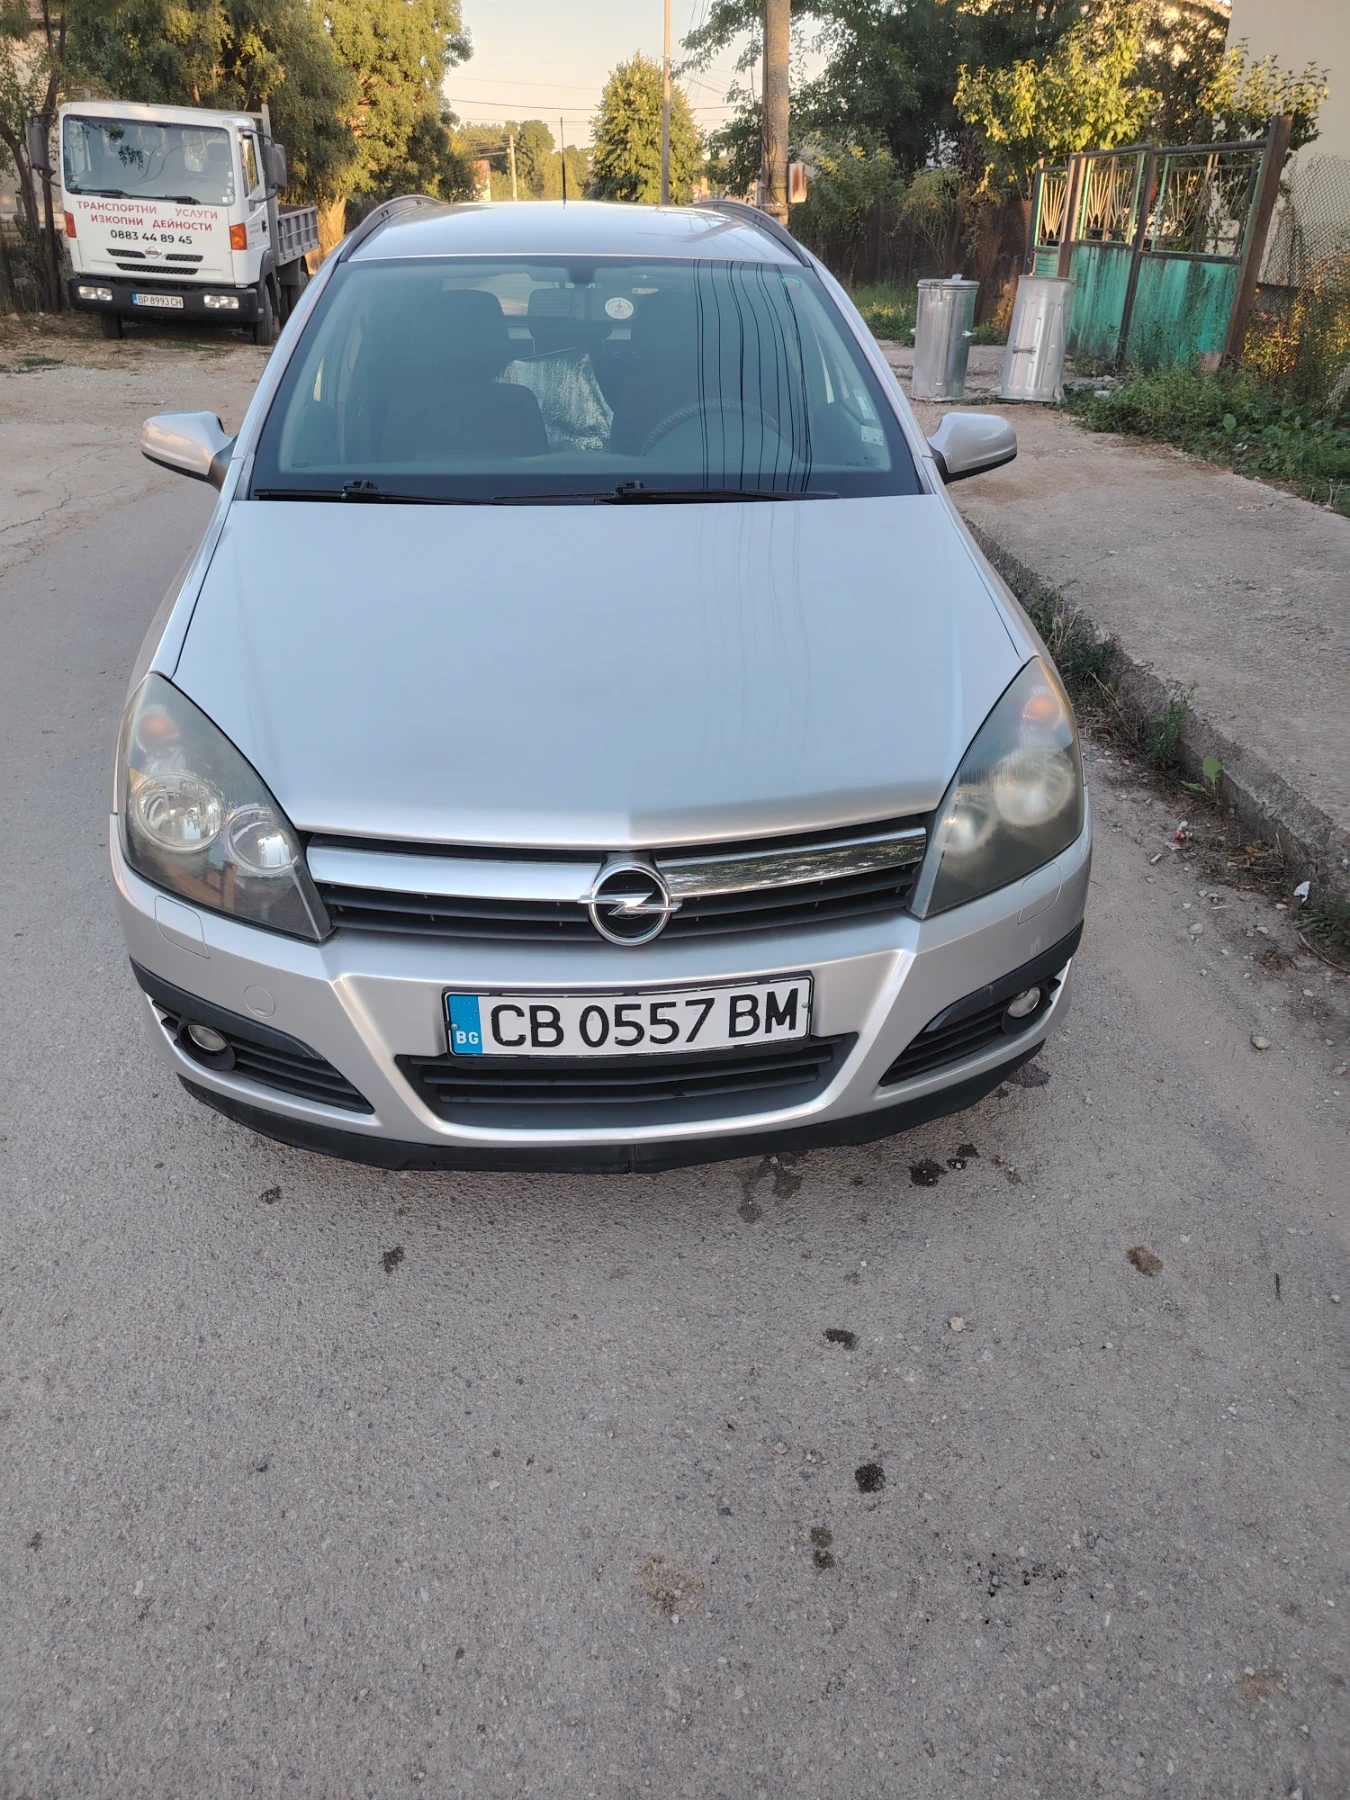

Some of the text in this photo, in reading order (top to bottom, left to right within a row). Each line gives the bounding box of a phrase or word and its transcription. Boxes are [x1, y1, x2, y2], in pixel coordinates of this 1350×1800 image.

[77, 200, 218, 219] ТРАНСПОРТНИ УСЛУГИ
[91, 214, 212, 231] ИЗКОПНИ ДЕЙНОСТИ
[110, 229, 193, 245] 0883 44 89 45
[579, 997, 716, 1049] 0557
[455, 1030, 479, 1045] BG
